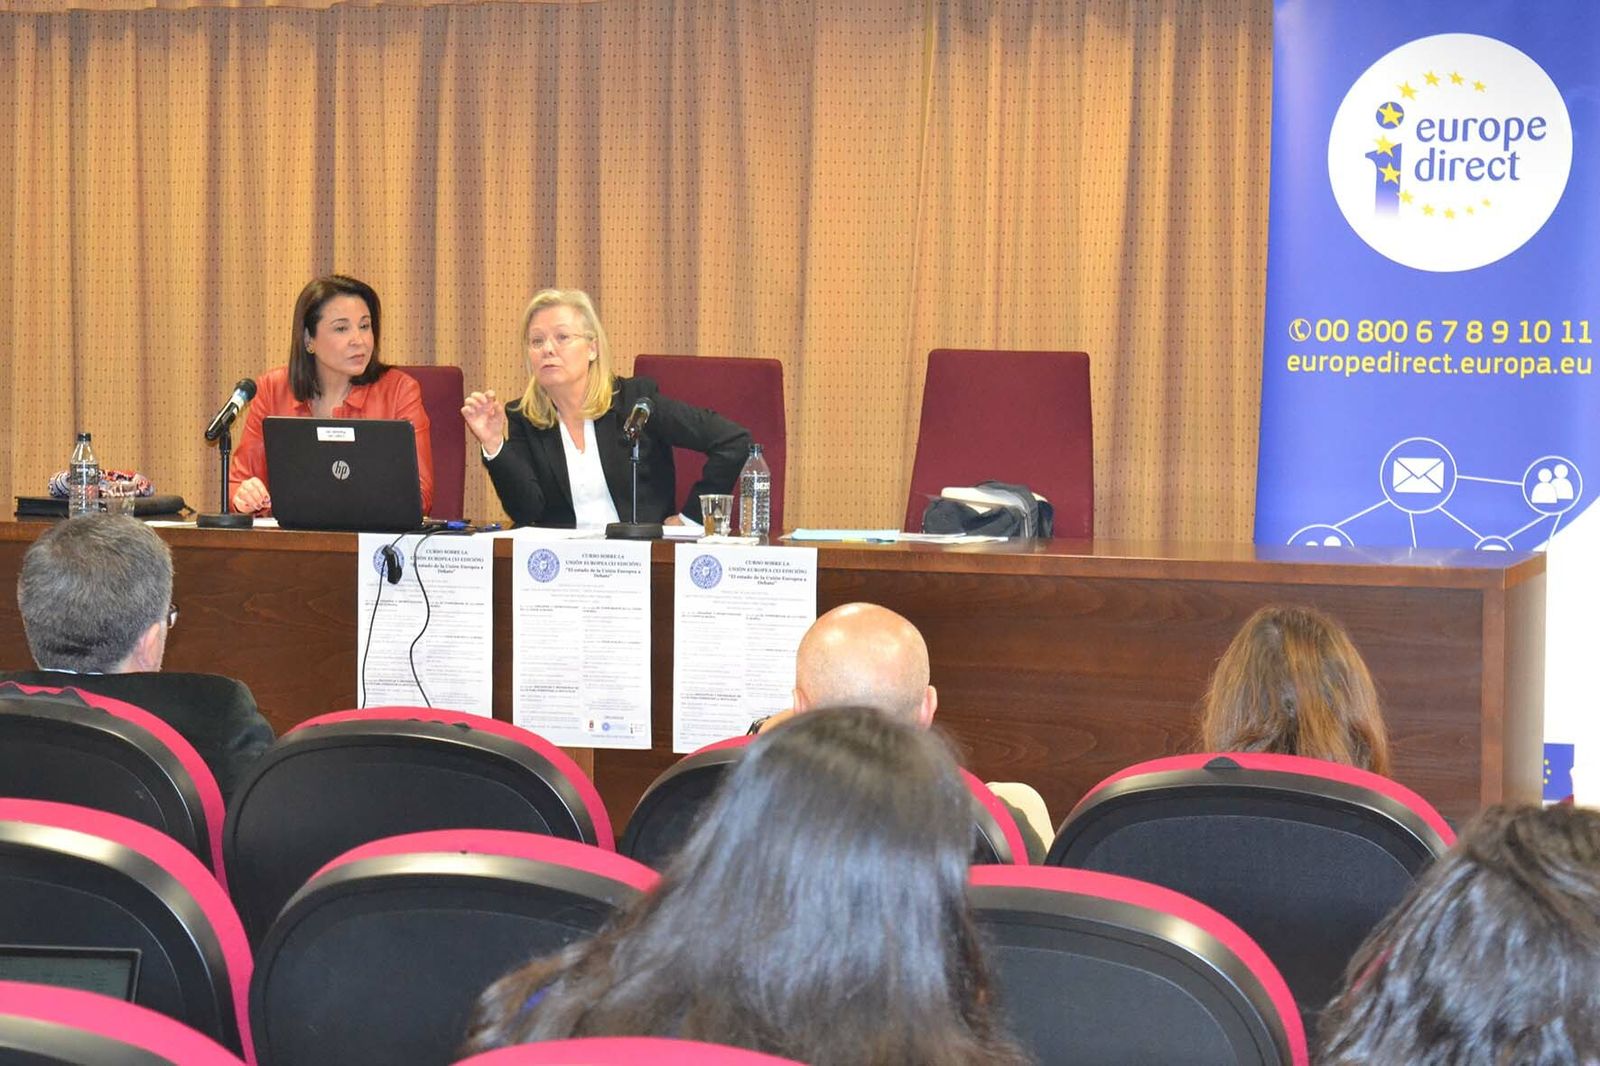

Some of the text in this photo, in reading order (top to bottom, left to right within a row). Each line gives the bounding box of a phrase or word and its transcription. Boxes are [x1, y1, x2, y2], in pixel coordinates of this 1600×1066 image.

[1416, 116, 1547, 151] europe
[1415, 147, 1521, 182] direct
[1315, 320, 1592, 344] 00 800 6 7 8 9 10 11
[1286, 350, 1592, 378] europedirect.europa.eu
